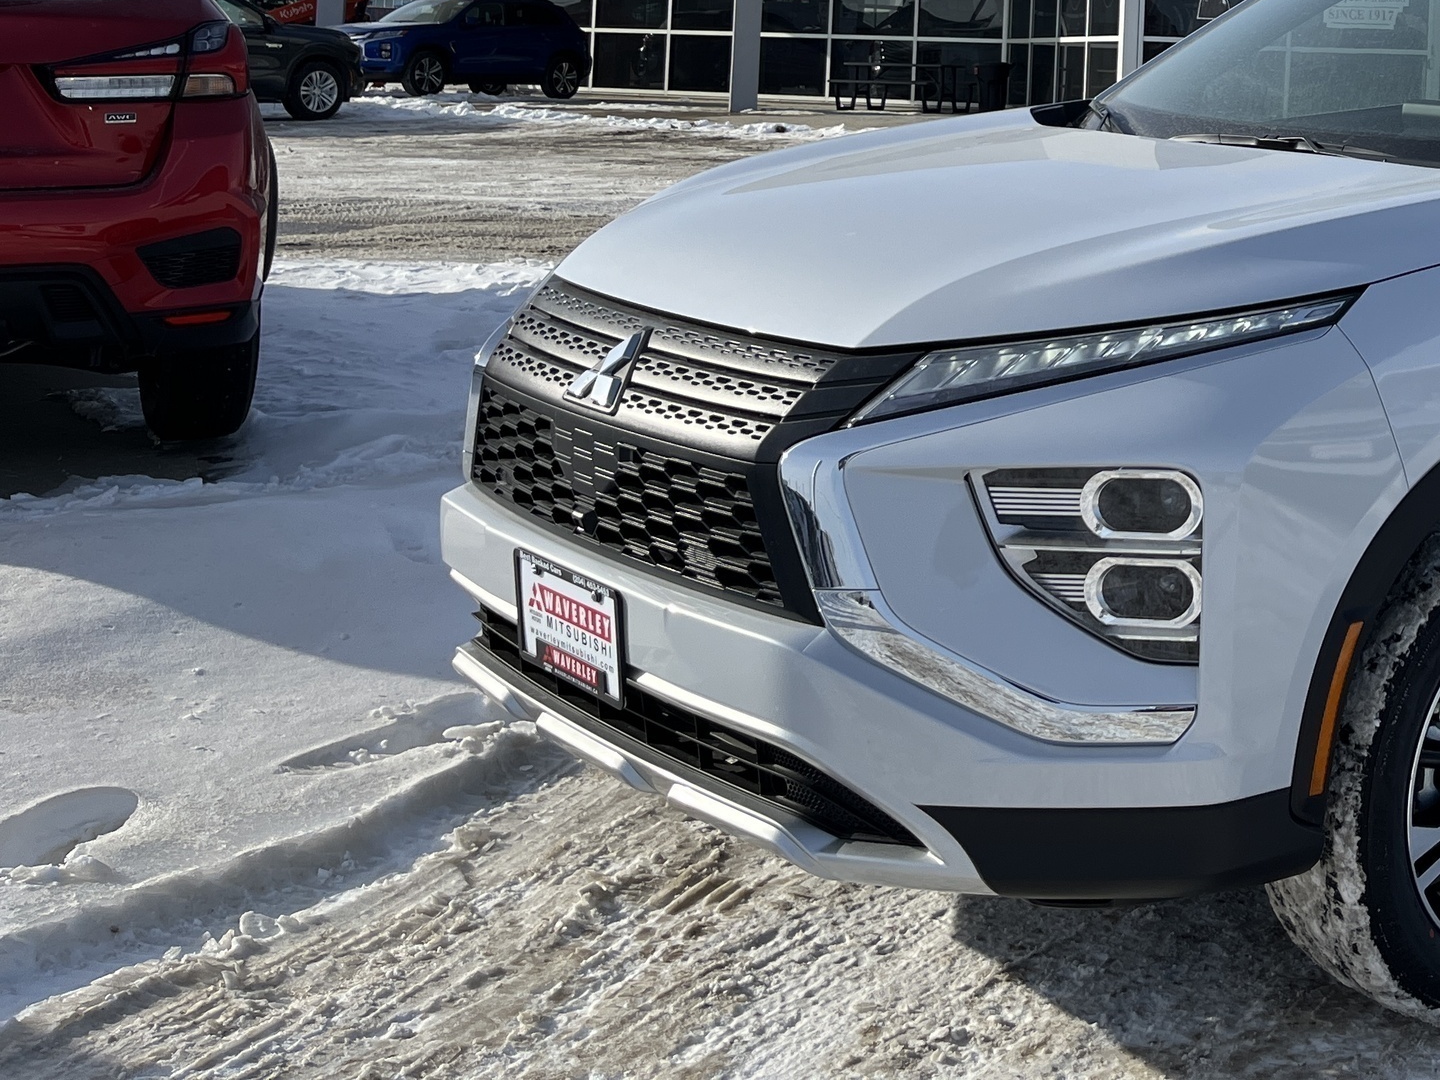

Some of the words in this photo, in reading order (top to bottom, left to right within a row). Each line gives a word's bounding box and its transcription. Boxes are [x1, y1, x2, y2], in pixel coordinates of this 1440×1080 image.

[1328, 8, 1364, 21] SINCE
[1368, 9, 1394, 21] 1917
[543, 589, 610, 638] WAVERLEY
[530, 626, 615, 674] waverleymitsubishi.com
[546, 615, 612, 658] MITSUBISHI
[553, 649, 597, 684] WAVERLEY
